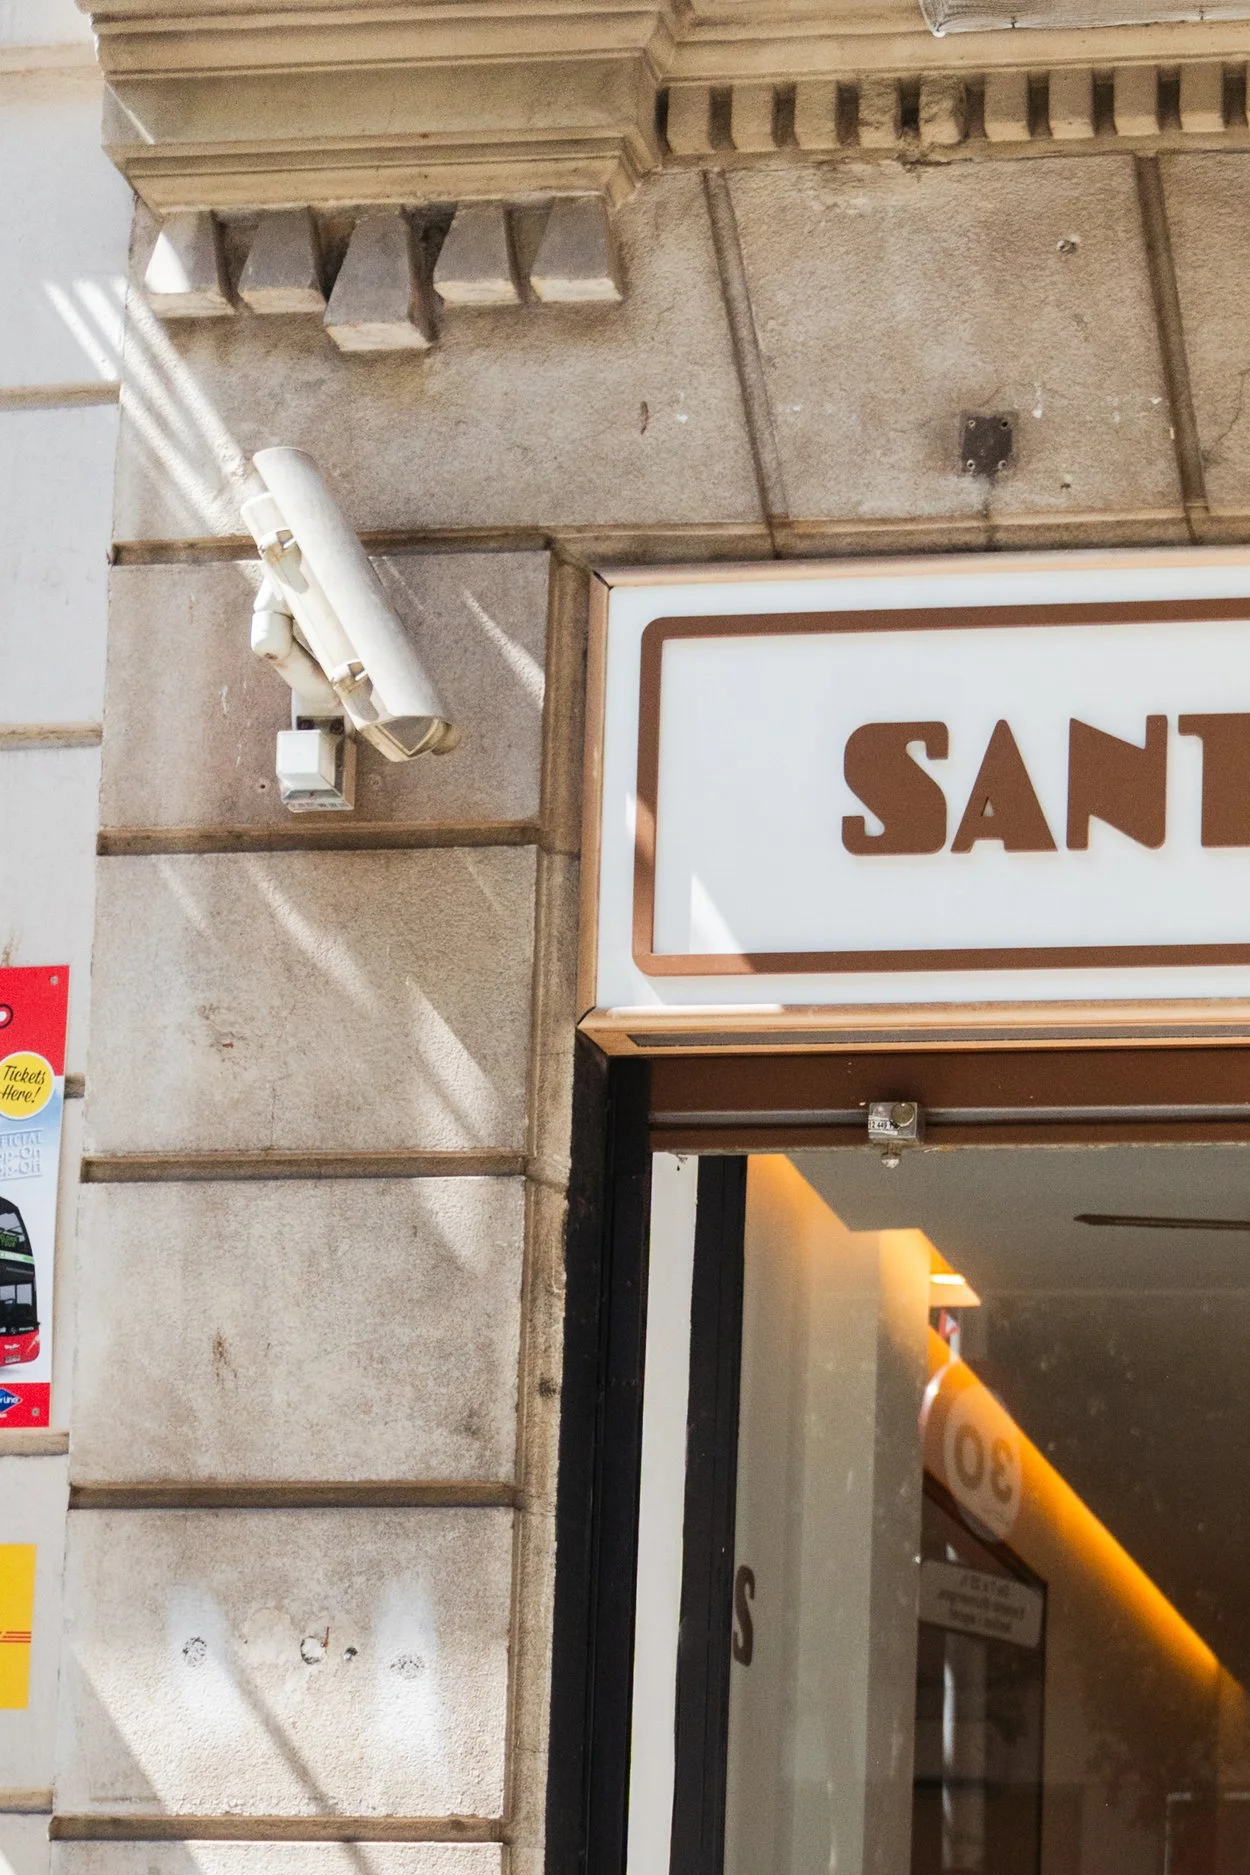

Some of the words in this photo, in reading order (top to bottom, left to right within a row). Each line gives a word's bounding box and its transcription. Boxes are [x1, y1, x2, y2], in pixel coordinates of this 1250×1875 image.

[3, 1064, 46, 1085] Tickets
[0, 1084, 42, 1103] Here!
[733, 1564, 756, 1668] S
